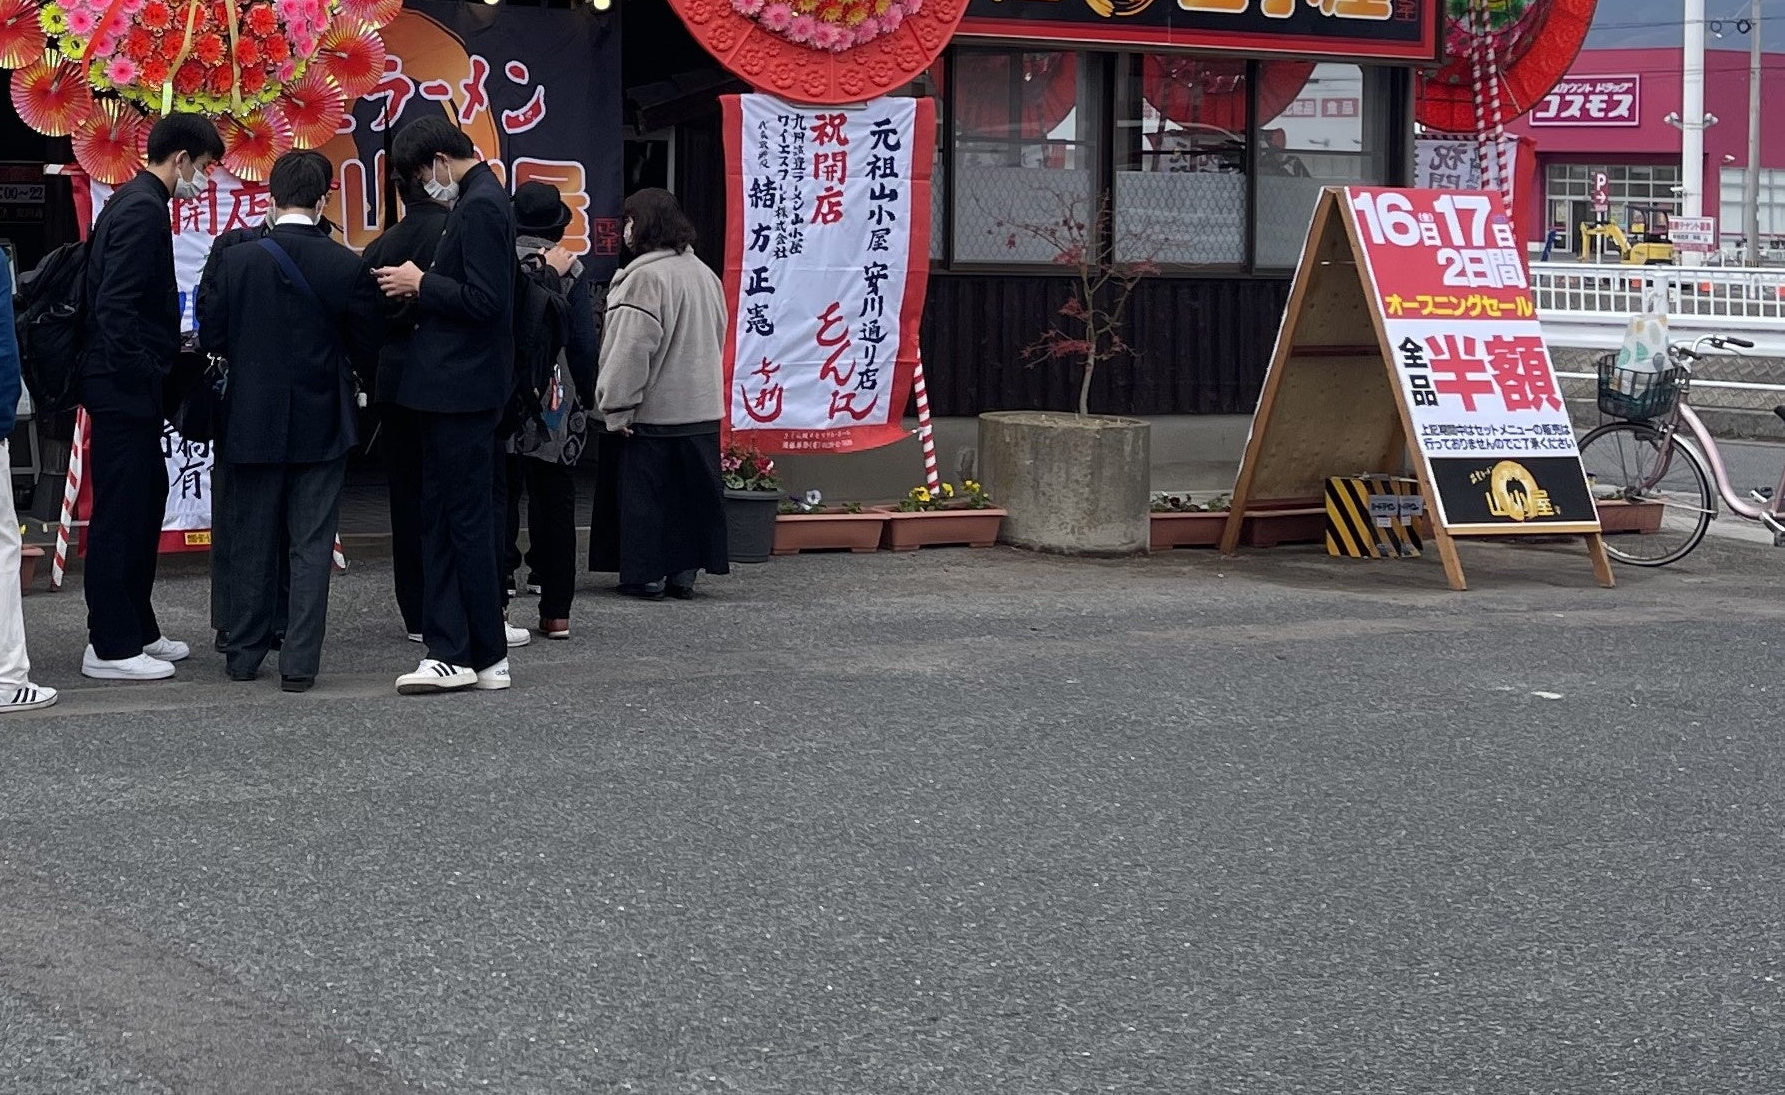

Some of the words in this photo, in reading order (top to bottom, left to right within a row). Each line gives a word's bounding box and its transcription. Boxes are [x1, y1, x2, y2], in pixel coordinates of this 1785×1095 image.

[1535, 94, 1634, 118] コスモス
[810, 112, 850, 226] 祝開店
[865, 117, 901, 253] 元祖山小屋
[1596, 173, 1607, 191] P
[1437, 248, 1528, 289] 2日間
[1384, 294, 1533, 318] オープニングセール
[1399, 336, 1439, 407] 全品
[1425, 334, 1563, 412] 半額
